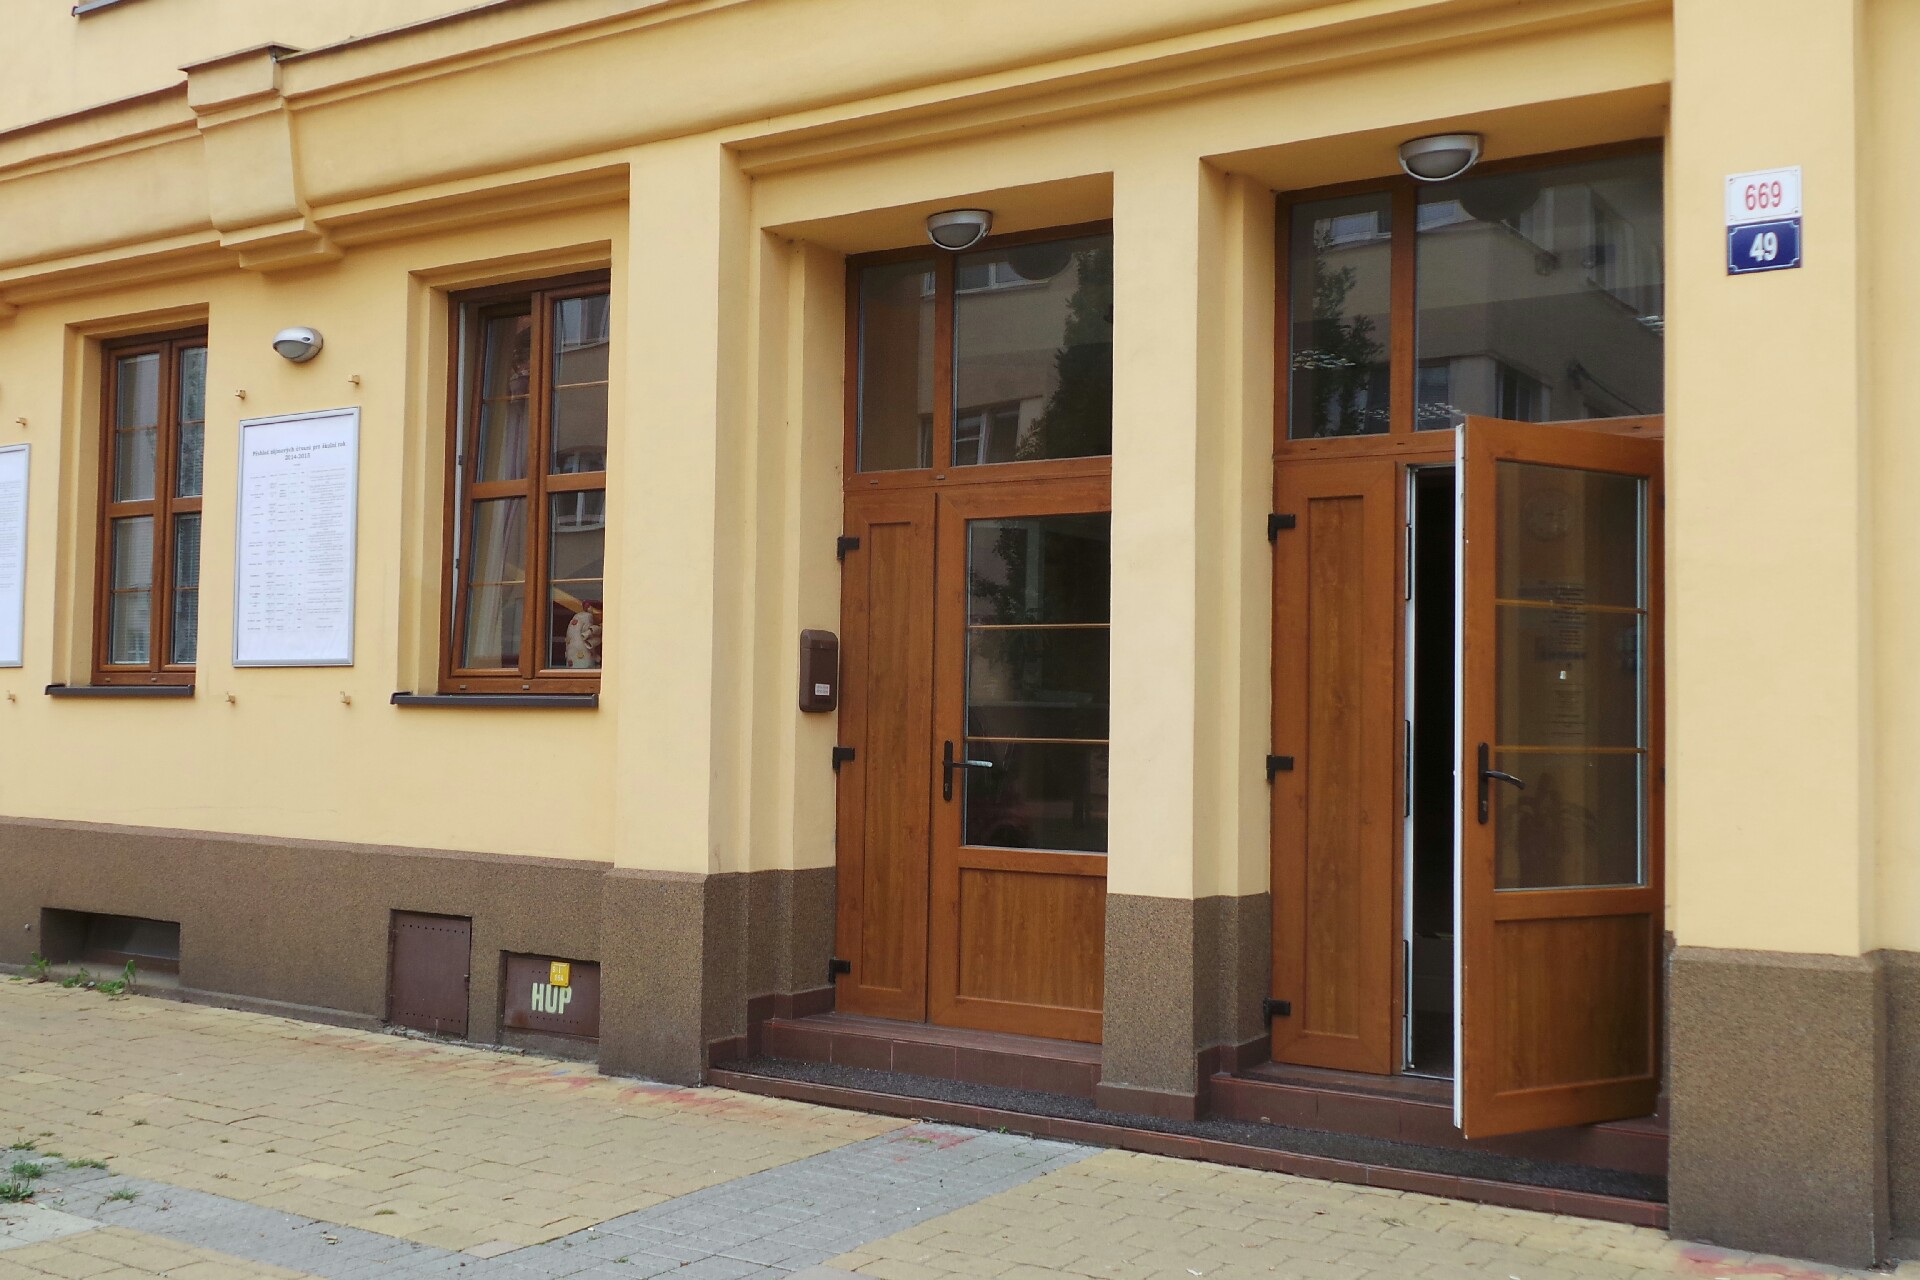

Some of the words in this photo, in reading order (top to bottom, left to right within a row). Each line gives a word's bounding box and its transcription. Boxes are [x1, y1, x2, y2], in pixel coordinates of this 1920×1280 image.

[1745, 180, 1782, 211] 669
[1749, 231, 1778, 262] 49
[284, 452, 311, 461] 2014-2015
[531, 982, 572, 1014] HUP
